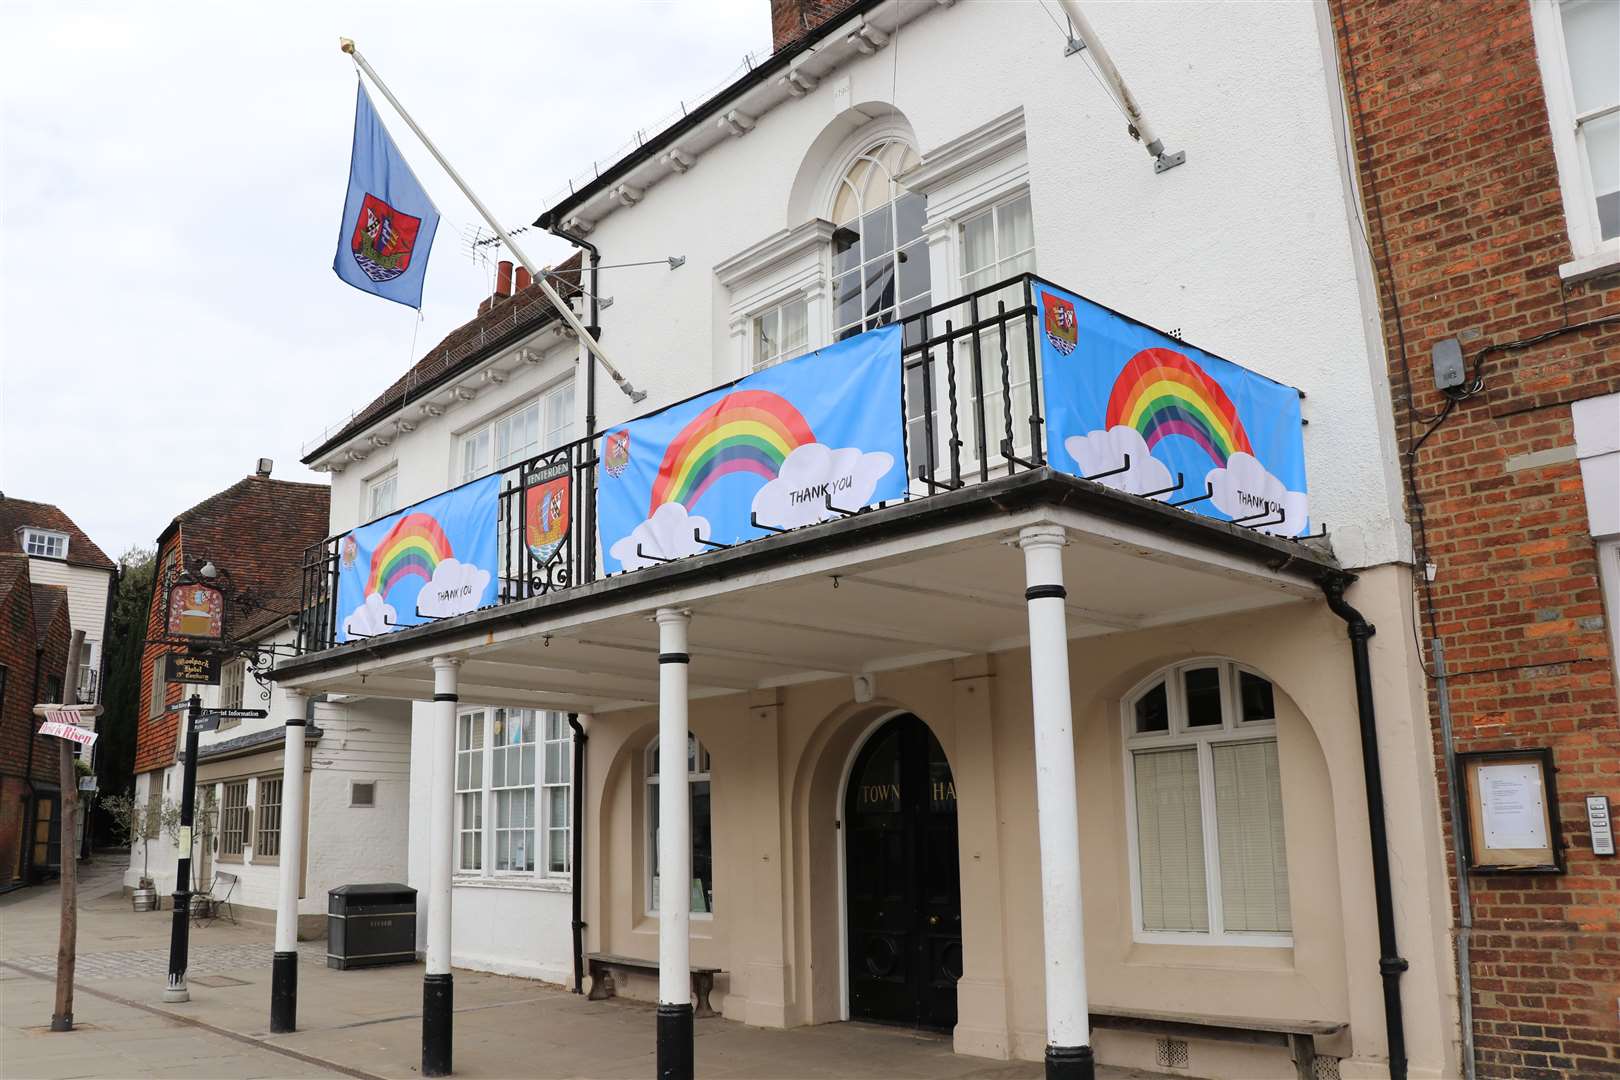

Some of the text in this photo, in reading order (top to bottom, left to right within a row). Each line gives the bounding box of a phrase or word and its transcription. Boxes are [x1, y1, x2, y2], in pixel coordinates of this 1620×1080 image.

[528, 462, 569, 485] TENTERDEN
[789, 475, 853, 506] THANK YOU
[1237, 490, 1265, 509] THANK
[437, 584, 473, 601] THANK YOU
[62, 726, 92, 744] Risen
[863, 784, 901, 802] TOWN
